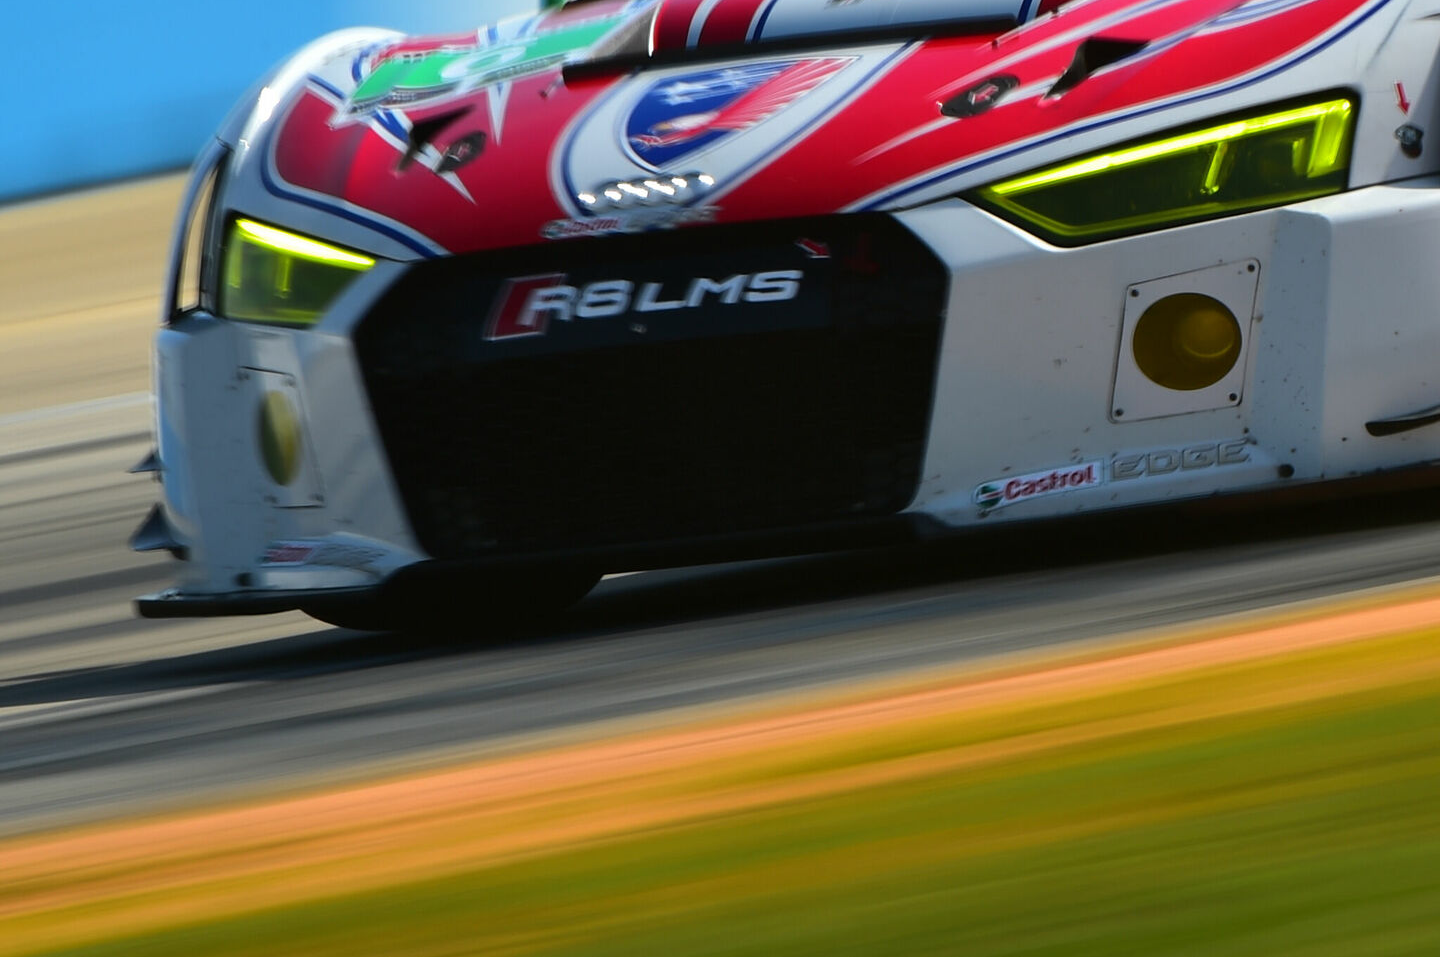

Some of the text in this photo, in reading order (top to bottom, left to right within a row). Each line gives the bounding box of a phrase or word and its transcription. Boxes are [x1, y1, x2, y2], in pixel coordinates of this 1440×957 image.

[515, 270, 804, 326] R8 LMS
[1003, 438, 1256, 501] Castrol EDGE
